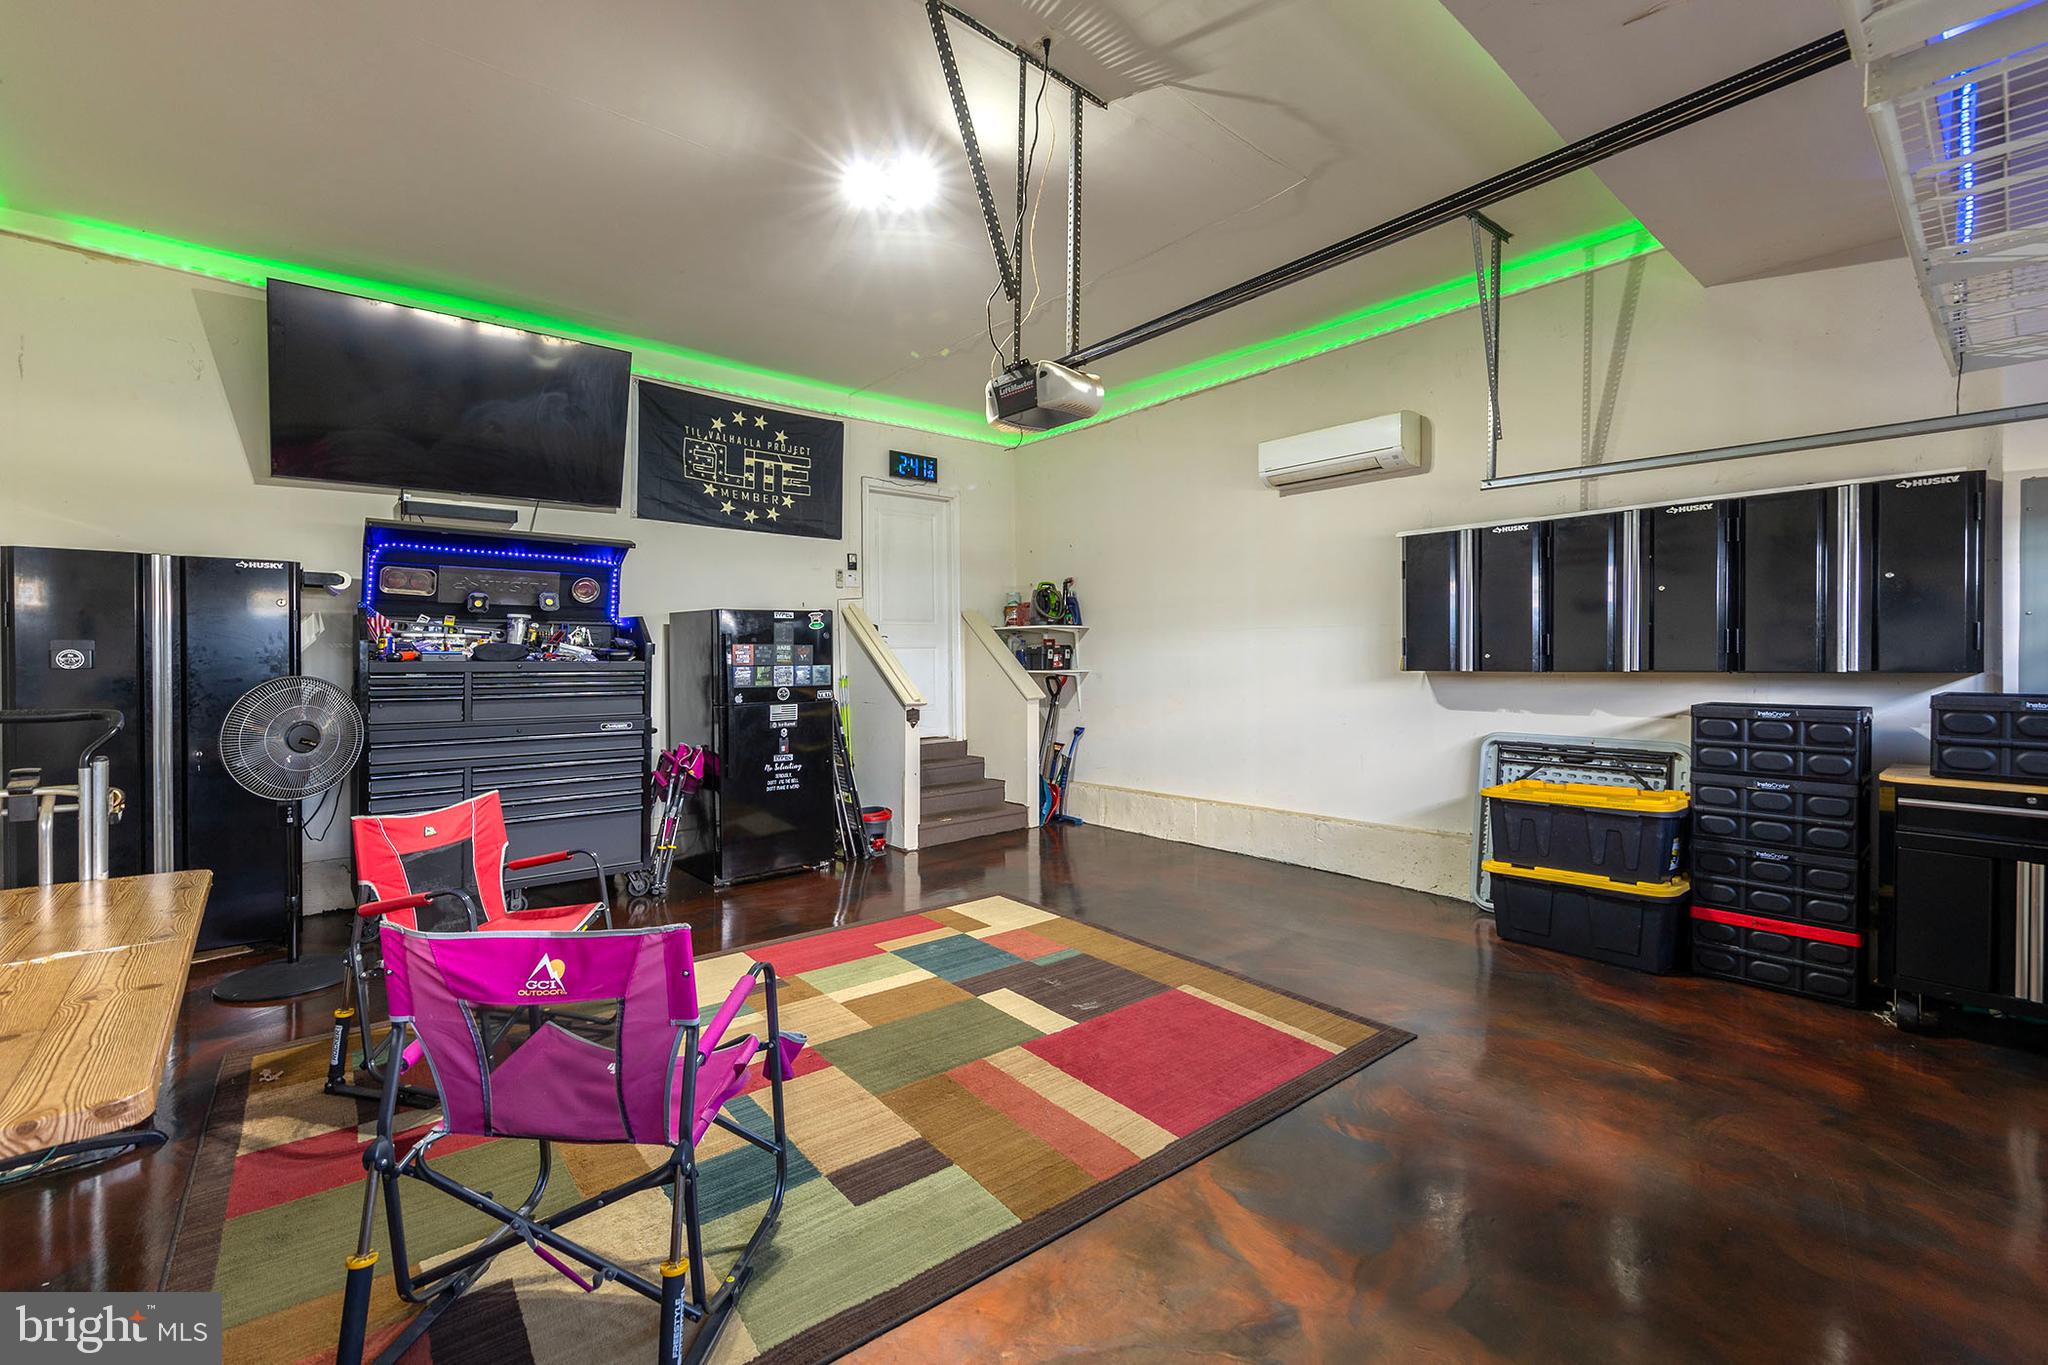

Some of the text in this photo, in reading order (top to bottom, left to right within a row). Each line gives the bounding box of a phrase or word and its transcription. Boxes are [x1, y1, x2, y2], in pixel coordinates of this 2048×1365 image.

[684, 425, 811, 456] TIL VALHALLA PROJECT
[1912, 475, 1960, 487] HUSKY
[721, 487, 779, 504] MEMBER
[1679, 503, 1713, 513] HUSKY
[1502, 524, 1529, 533] HUSKY
[249, 561, 284, 569] HUSKY
[2026, 701, 2048, 709] Insta
[525, 980, 558, 990] GCI
[672, 1298, 681, 1359] FREESTYLE
